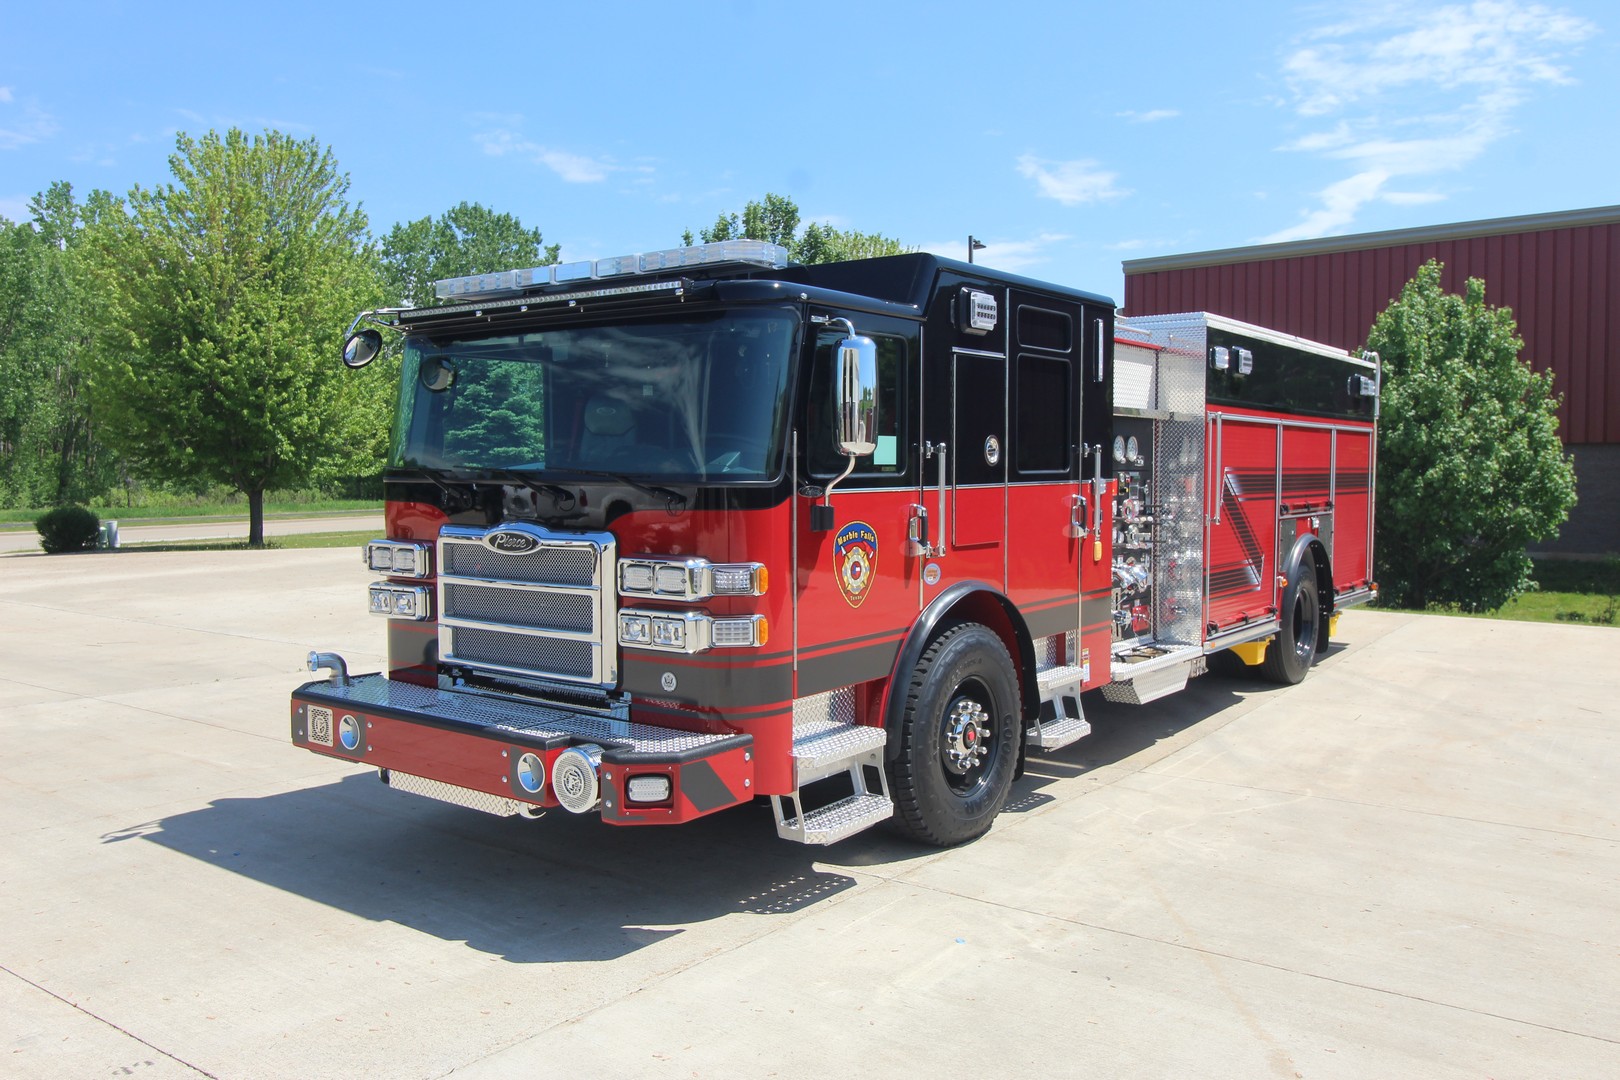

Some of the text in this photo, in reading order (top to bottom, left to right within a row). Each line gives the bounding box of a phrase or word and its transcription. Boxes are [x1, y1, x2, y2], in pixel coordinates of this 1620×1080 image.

[495, 533, 527, 549] Pierce
[837, 530, 874, 545] Marble Falls
